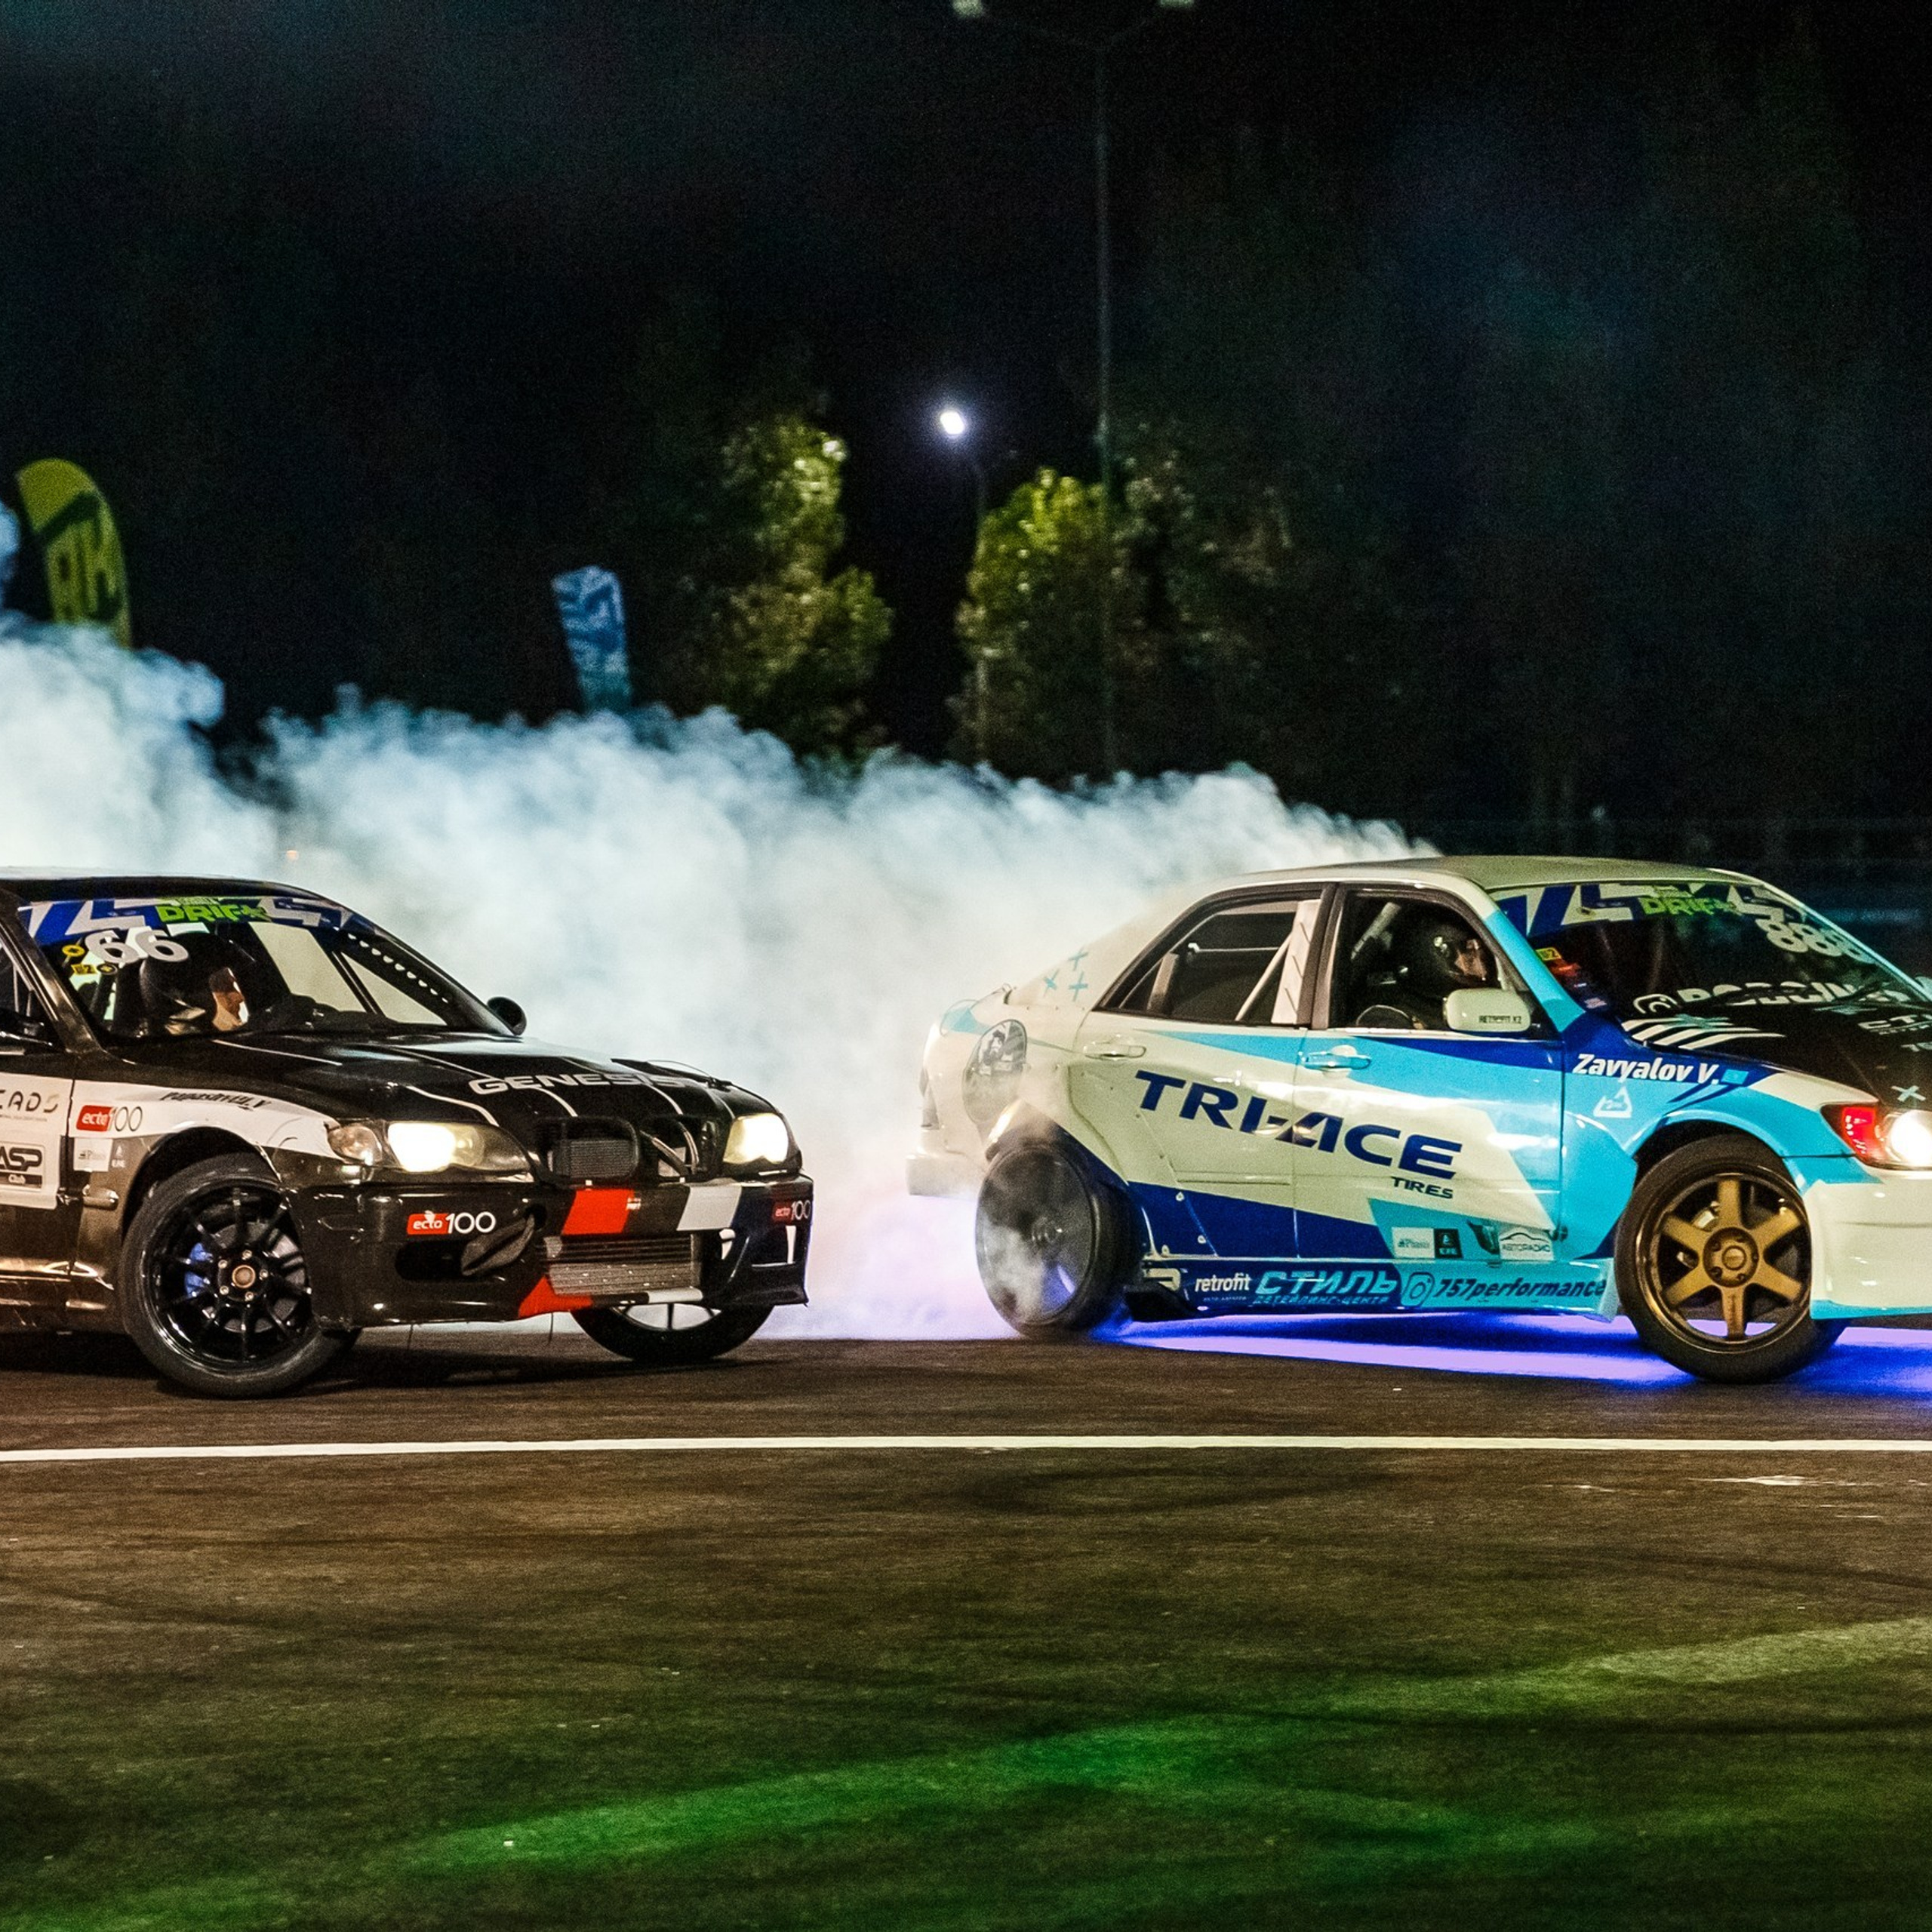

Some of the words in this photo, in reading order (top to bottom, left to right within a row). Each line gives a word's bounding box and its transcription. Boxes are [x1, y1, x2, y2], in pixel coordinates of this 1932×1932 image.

[85, 929, 189, 964] 66
[1572, 1054, 1694, 1083] Zavyalov
[1698, 1063, 1720, 1085] V.
[469, 1073, 685, 1095] GENESIS
[1135, 1069, 1463, 1180] TRI-ACE
[1391, 1176, 1454, 1199] TIRES
[1195, 1272, 1252, 1292] retrofit
[1255, 1271, 1398, 1294] СТИЛЬ
